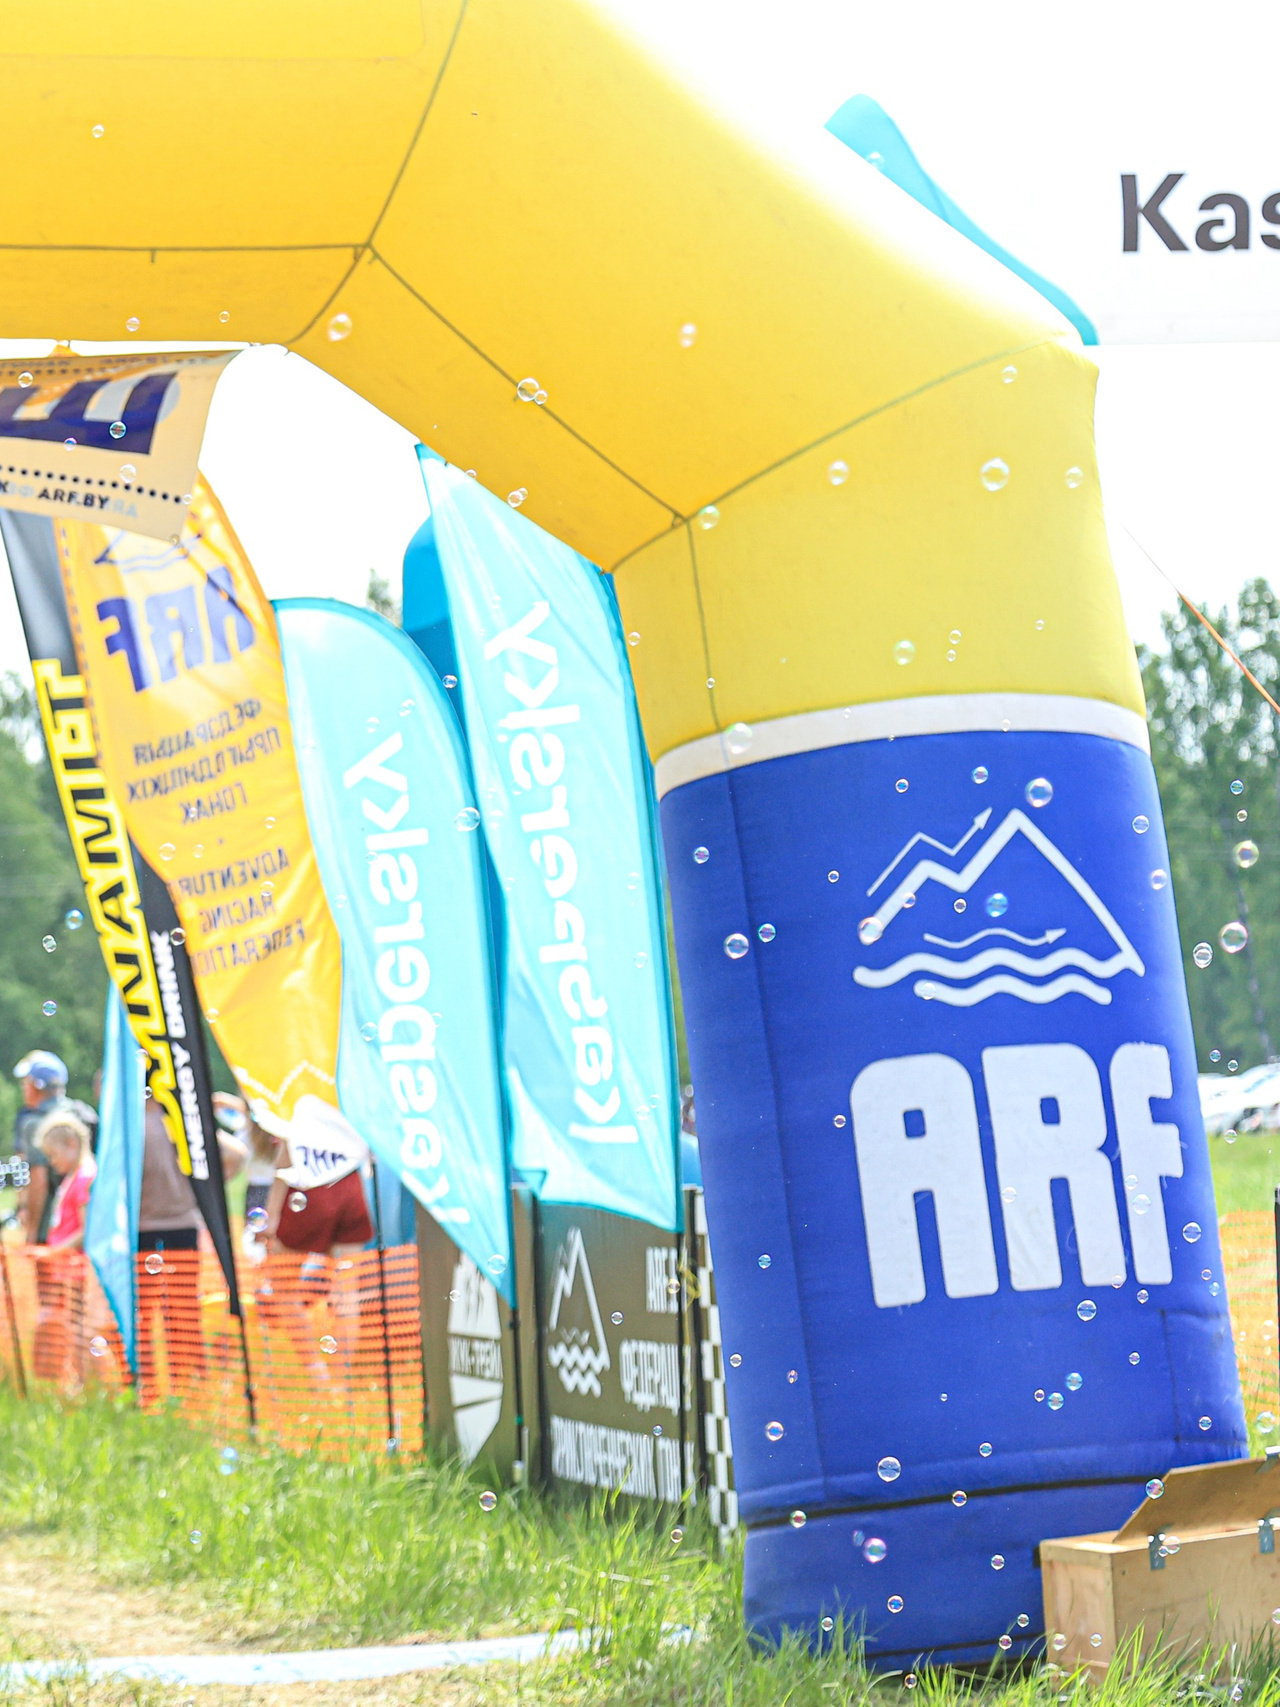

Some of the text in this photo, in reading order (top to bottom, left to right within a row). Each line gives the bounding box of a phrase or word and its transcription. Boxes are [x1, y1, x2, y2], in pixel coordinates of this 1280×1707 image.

[37, 487, 110, 510] ARF.BY
[850, 1042, 1184, 1309] ARF
[620, 1338, 692, 1416] ФЕДЕРАЦЯ
[657, 1436, 697, 1506] ГОНК
